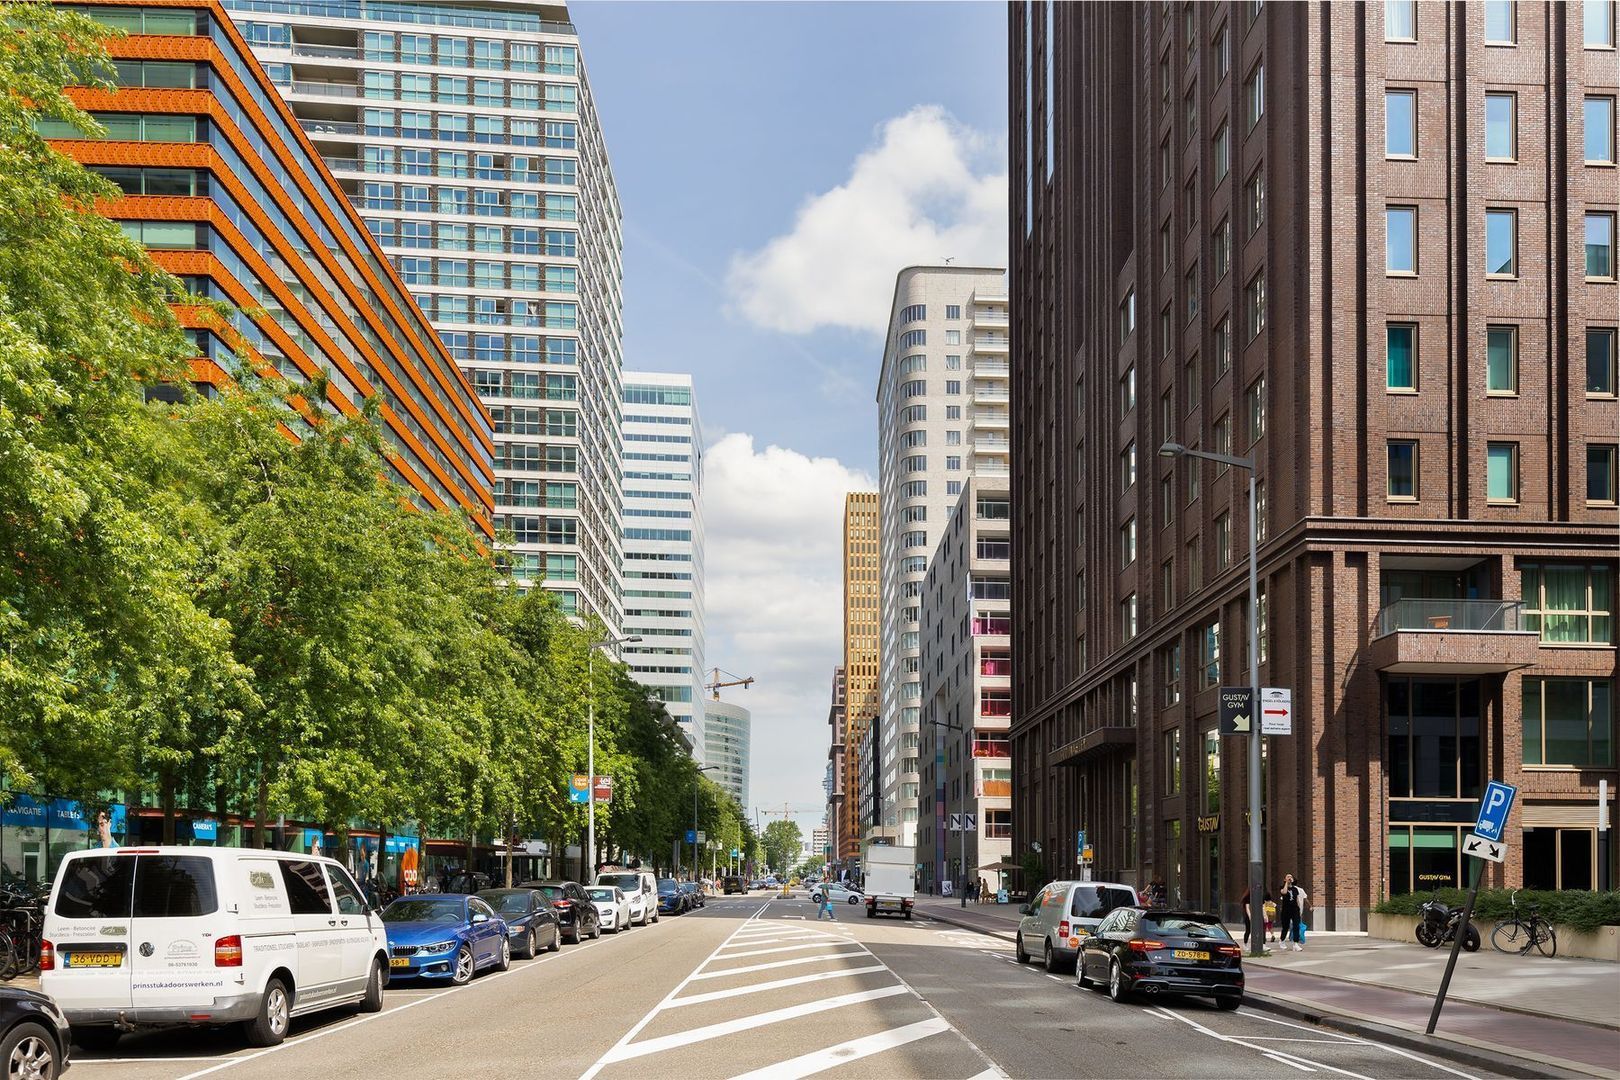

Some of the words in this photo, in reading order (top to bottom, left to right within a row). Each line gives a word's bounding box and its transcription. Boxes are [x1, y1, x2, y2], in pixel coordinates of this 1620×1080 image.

[1222, 693, 1250, 702] GUSTAV
[1486, 788, 1506, 815] P
[132, 980, 224, 990] prinsstukadoorswerken.nl
